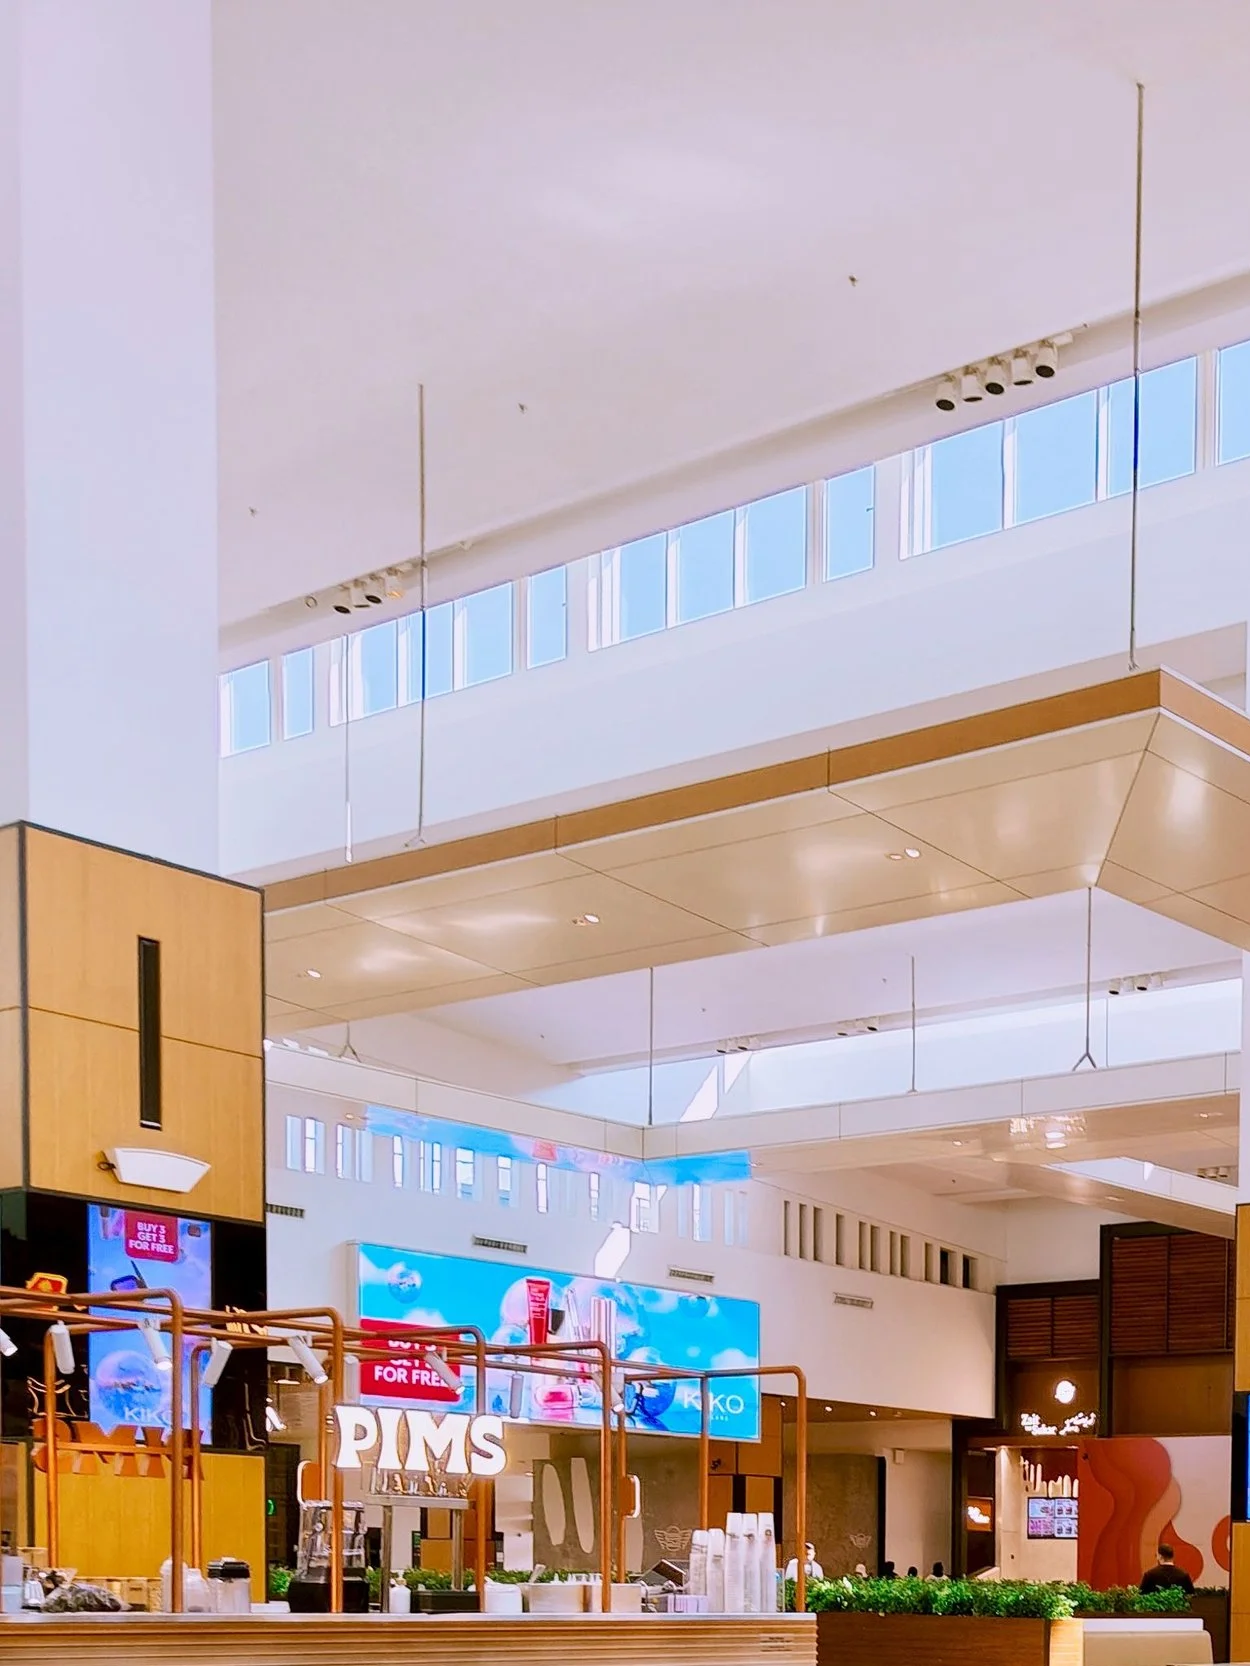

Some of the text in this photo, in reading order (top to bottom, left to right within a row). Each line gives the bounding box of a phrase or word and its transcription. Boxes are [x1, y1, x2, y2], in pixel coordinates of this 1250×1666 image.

[137, 1221, 166, 1234] BUY 3
[137, 1231, 166, 1244] GET 3
[129, 1240, 174, 1254] FOR FREE
[374, 1366, 408, 1384] FOR
[683, 1392, 745, 1414] KKO
[335, 1405, 507, 1476] PIMS
